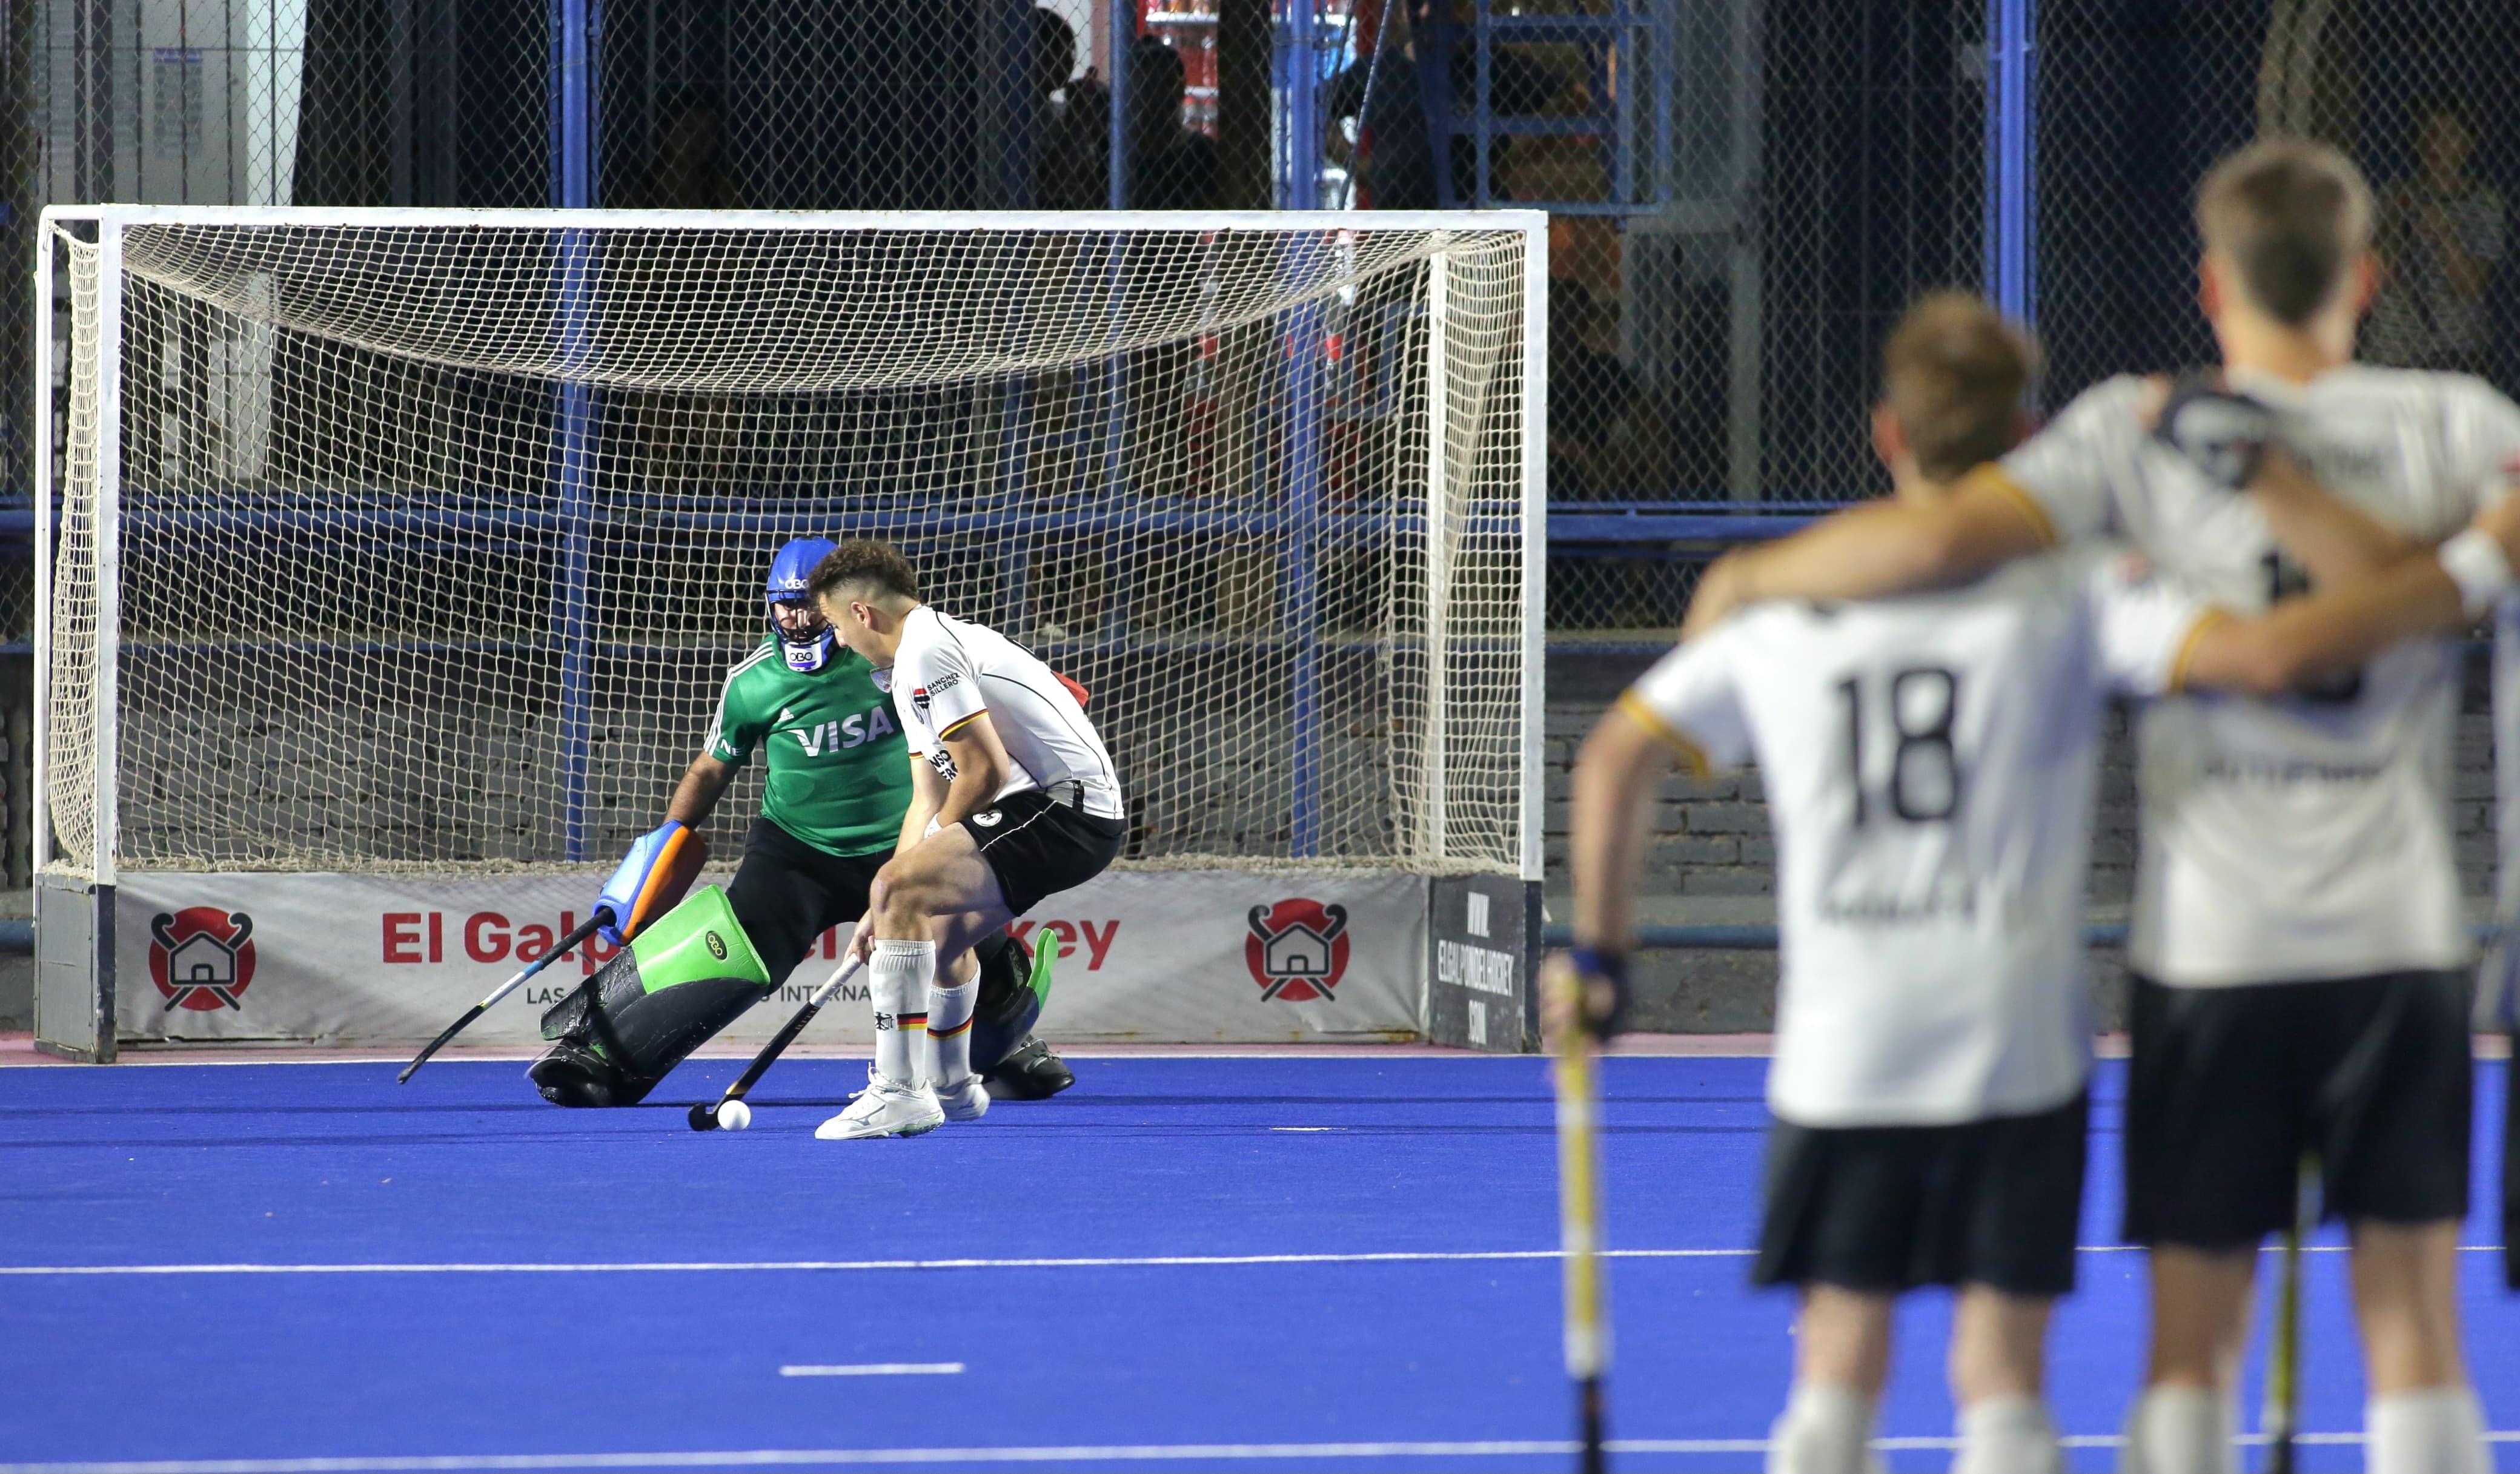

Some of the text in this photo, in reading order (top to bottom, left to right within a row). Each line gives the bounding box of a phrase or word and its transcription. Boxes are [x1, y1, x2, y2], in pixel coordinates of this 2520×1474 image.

[790, 652, 813, 662] OBO
[927, 673, 960, 691] SANCHEZ
[930, 679, 958, 696] SILLERO
[787, 706, 895, 757] VISA
[1837, 668, 1958, 825] 18
[383, 912, 442, 963] El
[464, 911, 621, 976] Galp
[708, 935, 723, 956] OBO
[526, 987, 564, 1004] LAS
